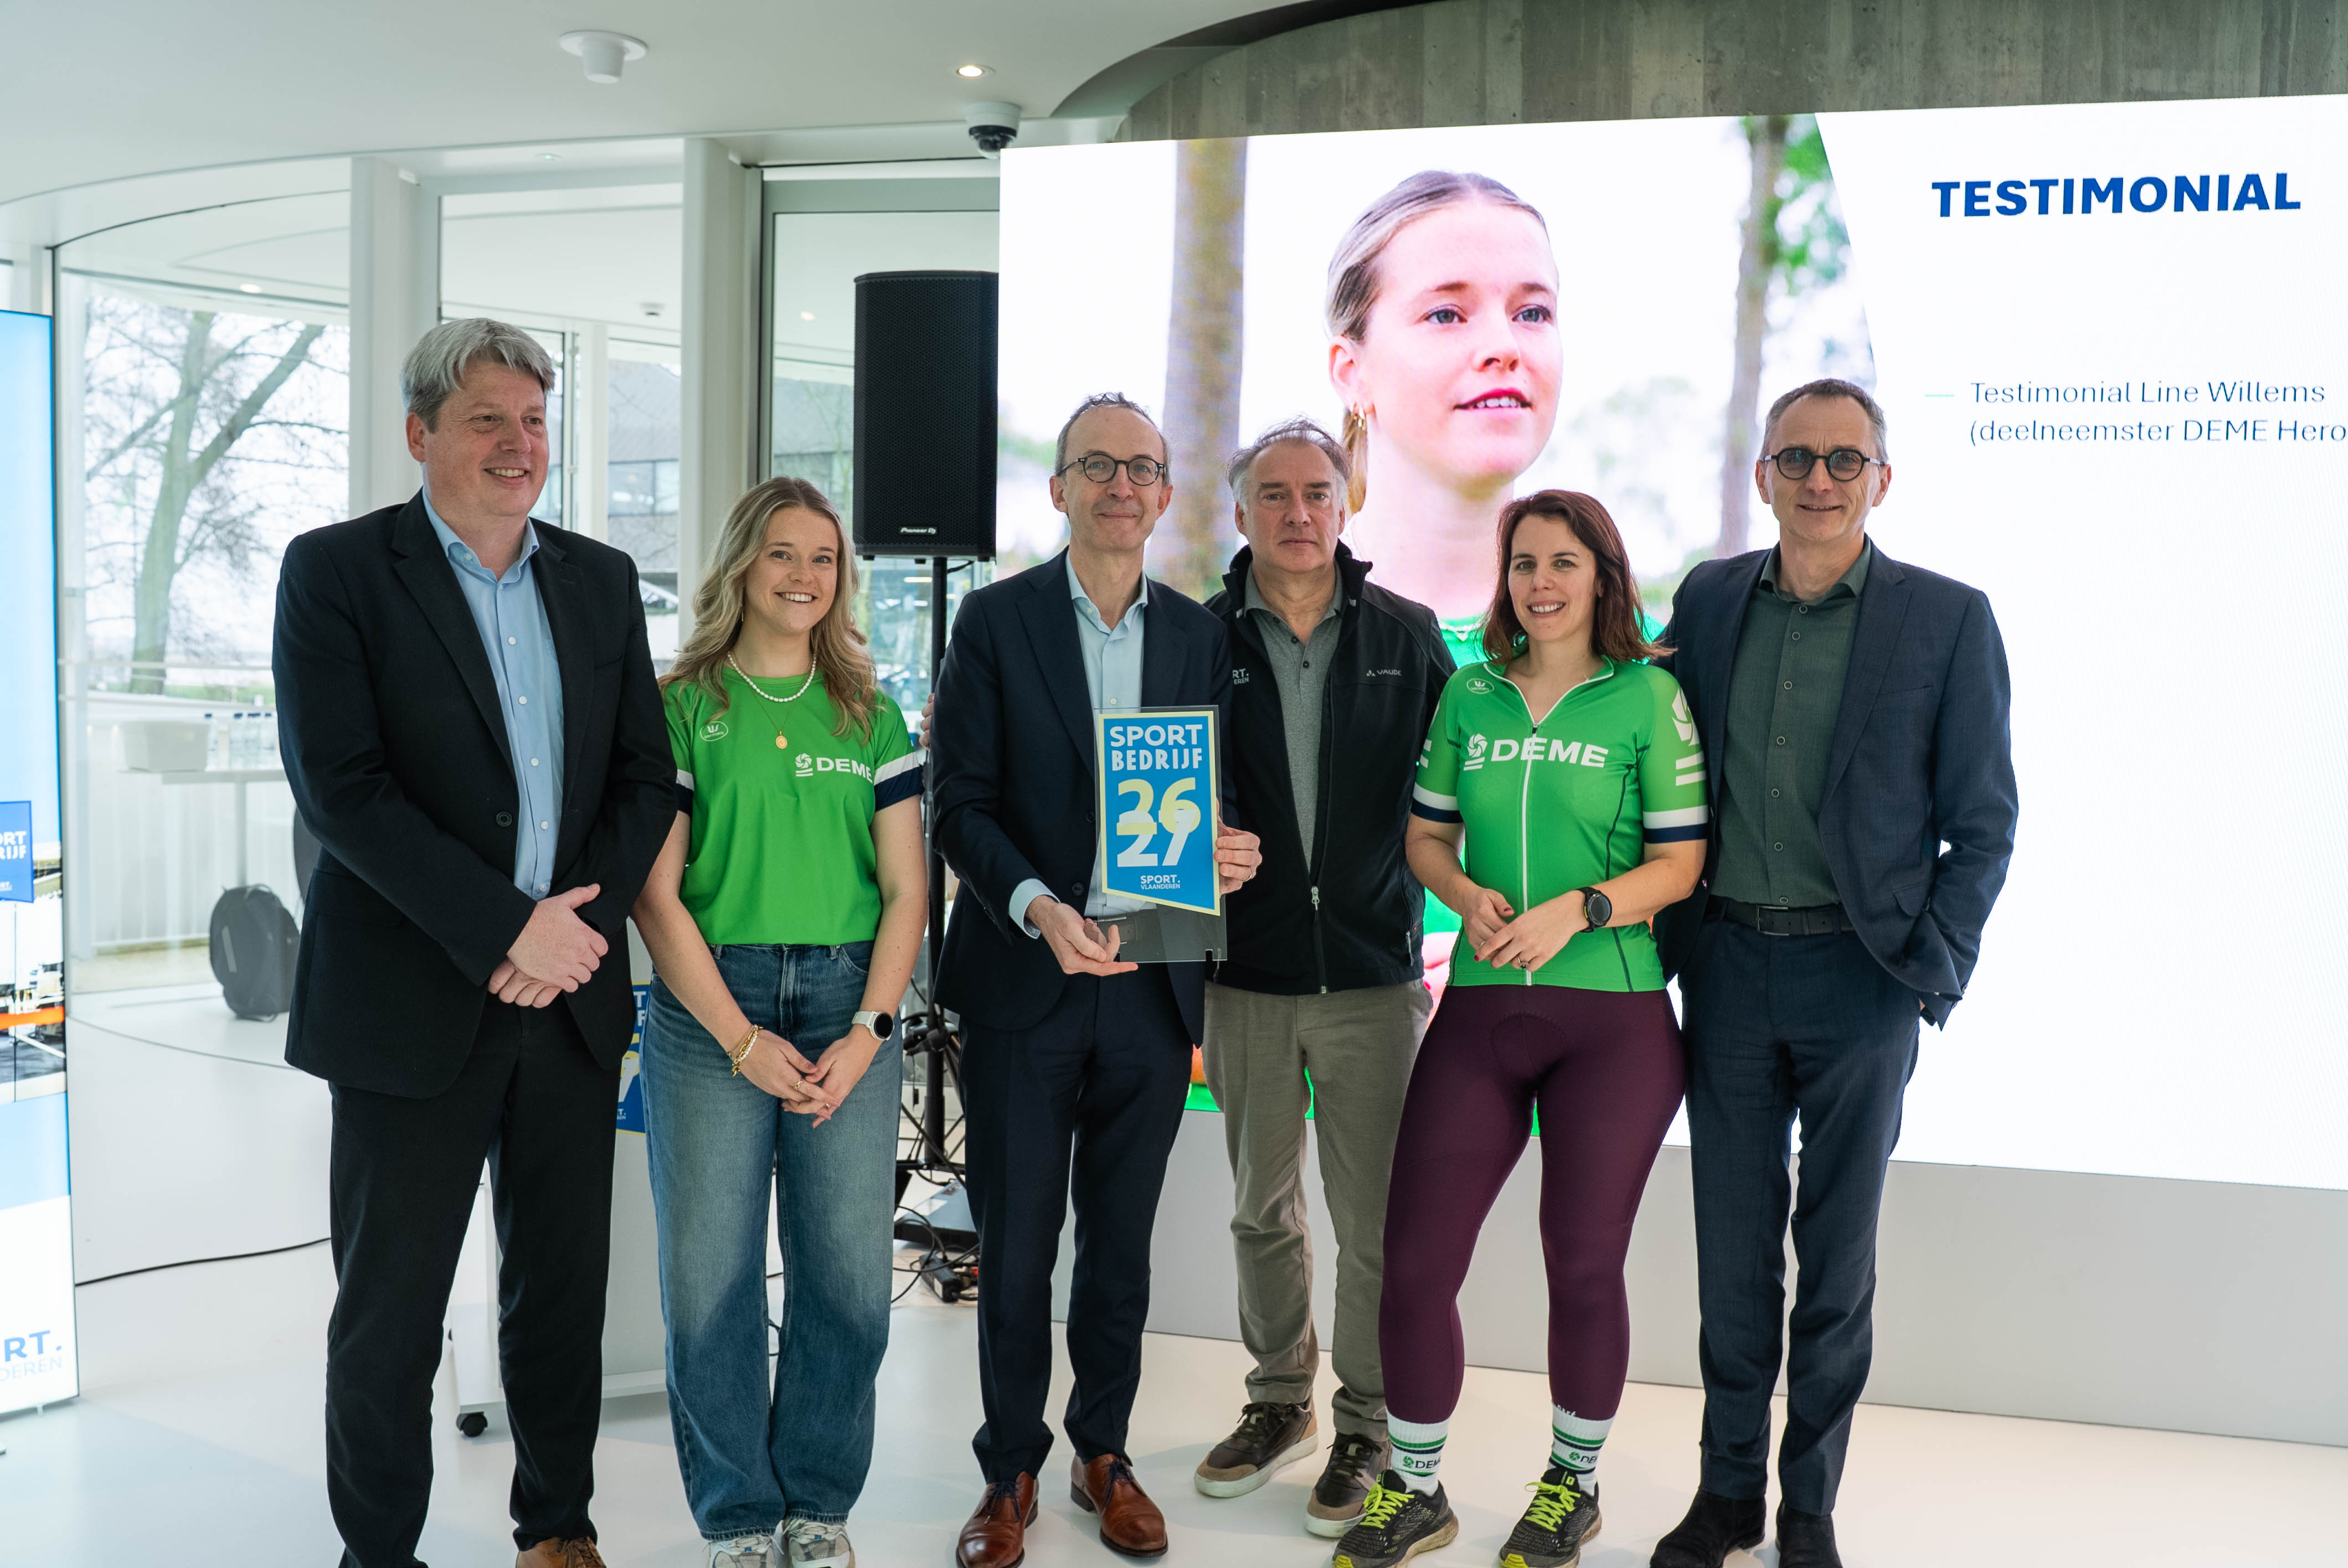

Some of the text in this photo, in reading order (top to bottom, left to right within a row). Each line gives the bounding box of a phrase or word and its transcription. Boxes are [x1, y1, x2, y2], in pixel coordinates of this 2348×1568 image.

[1932, 172, 2300, 217] TESTIMONIAL
[1971, 380, 2325, 403] Testimonial Line Willems
[1970, 420, 2347, 446] (deelneemster DEME Hero
[1109, 724, 1203, 747] SPORT
[1111, 747, 1202, 771] BEDRIJF
[1491, 737, 1609, 768] DEME
[816, 757, 873, 784] DEME
[1116, 777, 1201, 836] 26
[1117, 809, 1198, 868] 27
[1140, 874, 1181, 884] SPORT.
